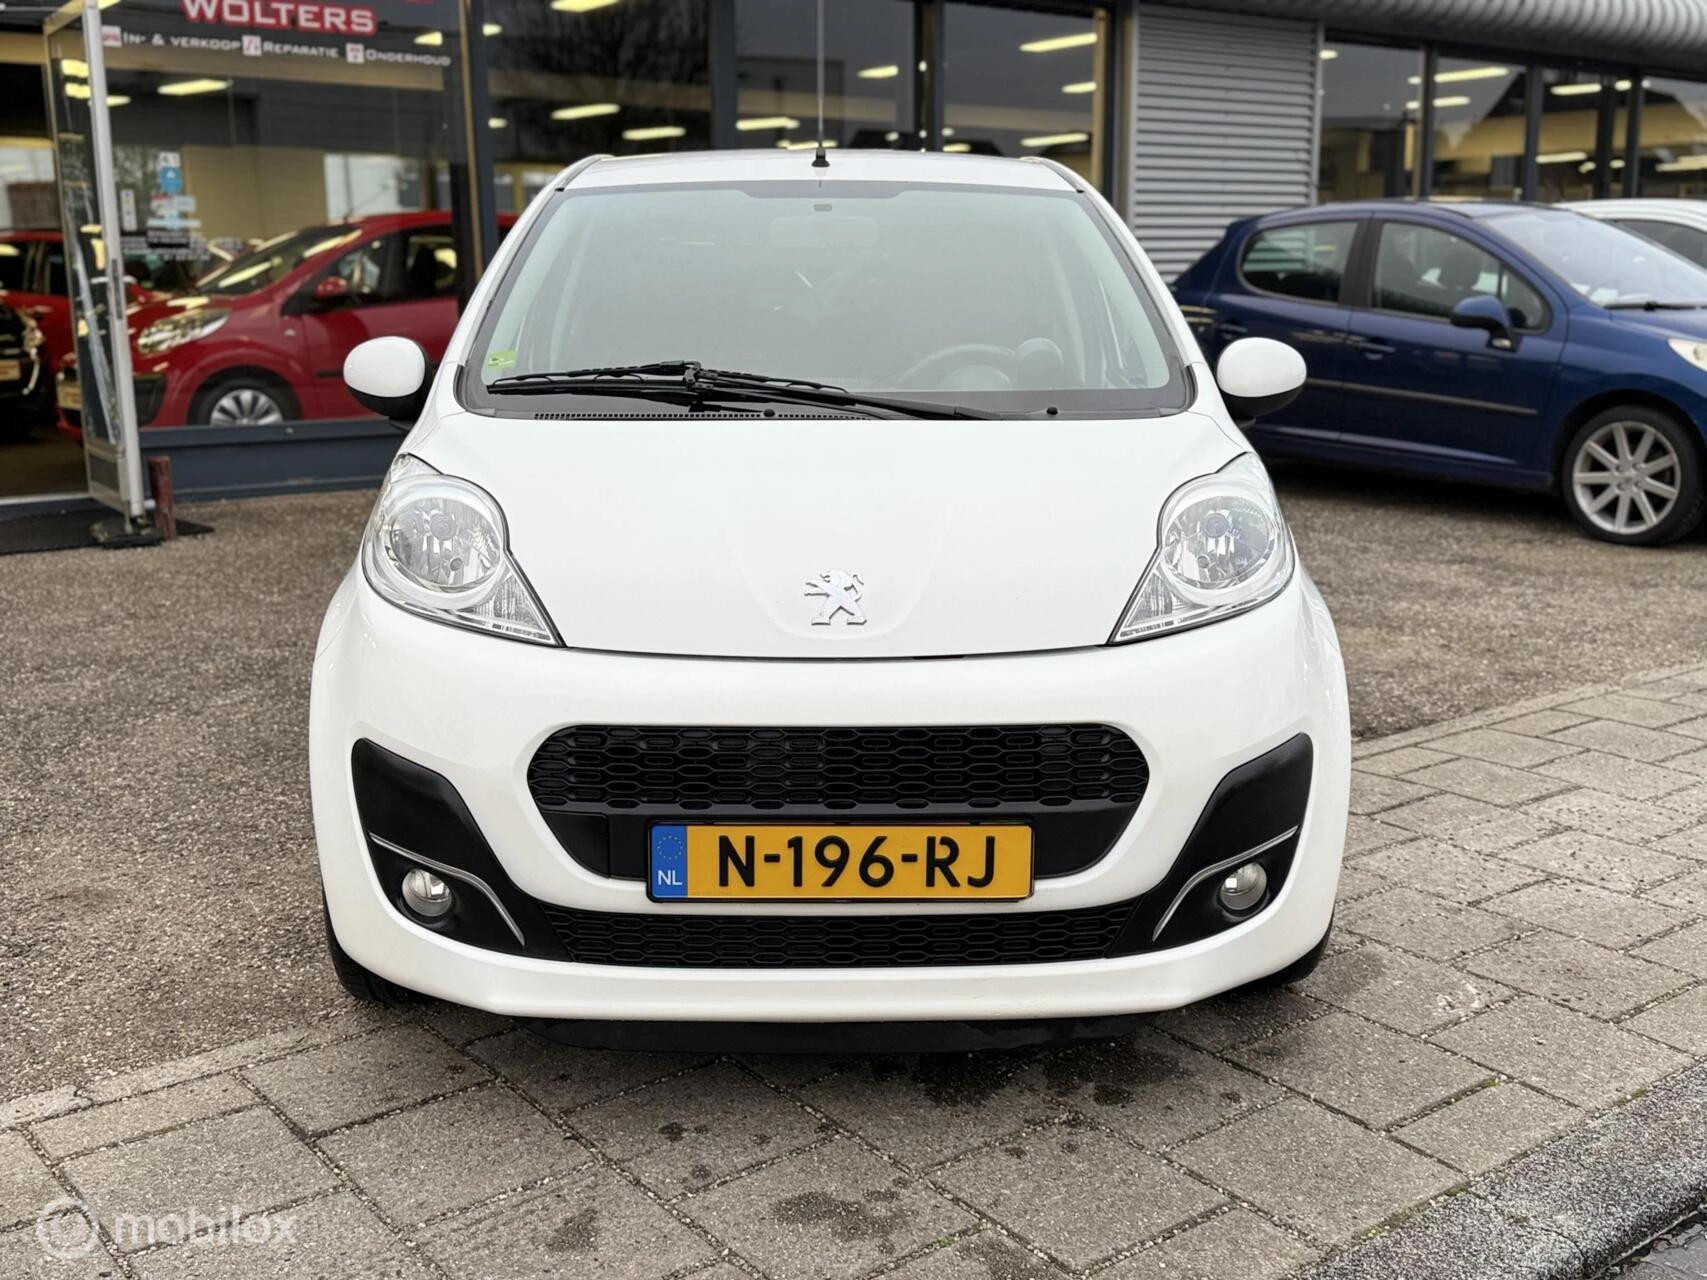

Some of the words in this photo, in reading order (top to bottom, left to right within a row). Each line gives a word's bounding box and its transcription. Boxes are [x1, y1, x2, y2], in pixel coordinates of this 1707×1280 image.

[182, 0, 374, 33] WOLTERS
[151, 32, 166, 47] &
[169, 35, 242, 51] VERKOOP
[262, 40, 341, 59] REPARATIE
[365, 48, 452, 67] ONDERHOUD
[717, 834, 997, 889] N-196-RJ
[657, 869, 683, 887] NL
